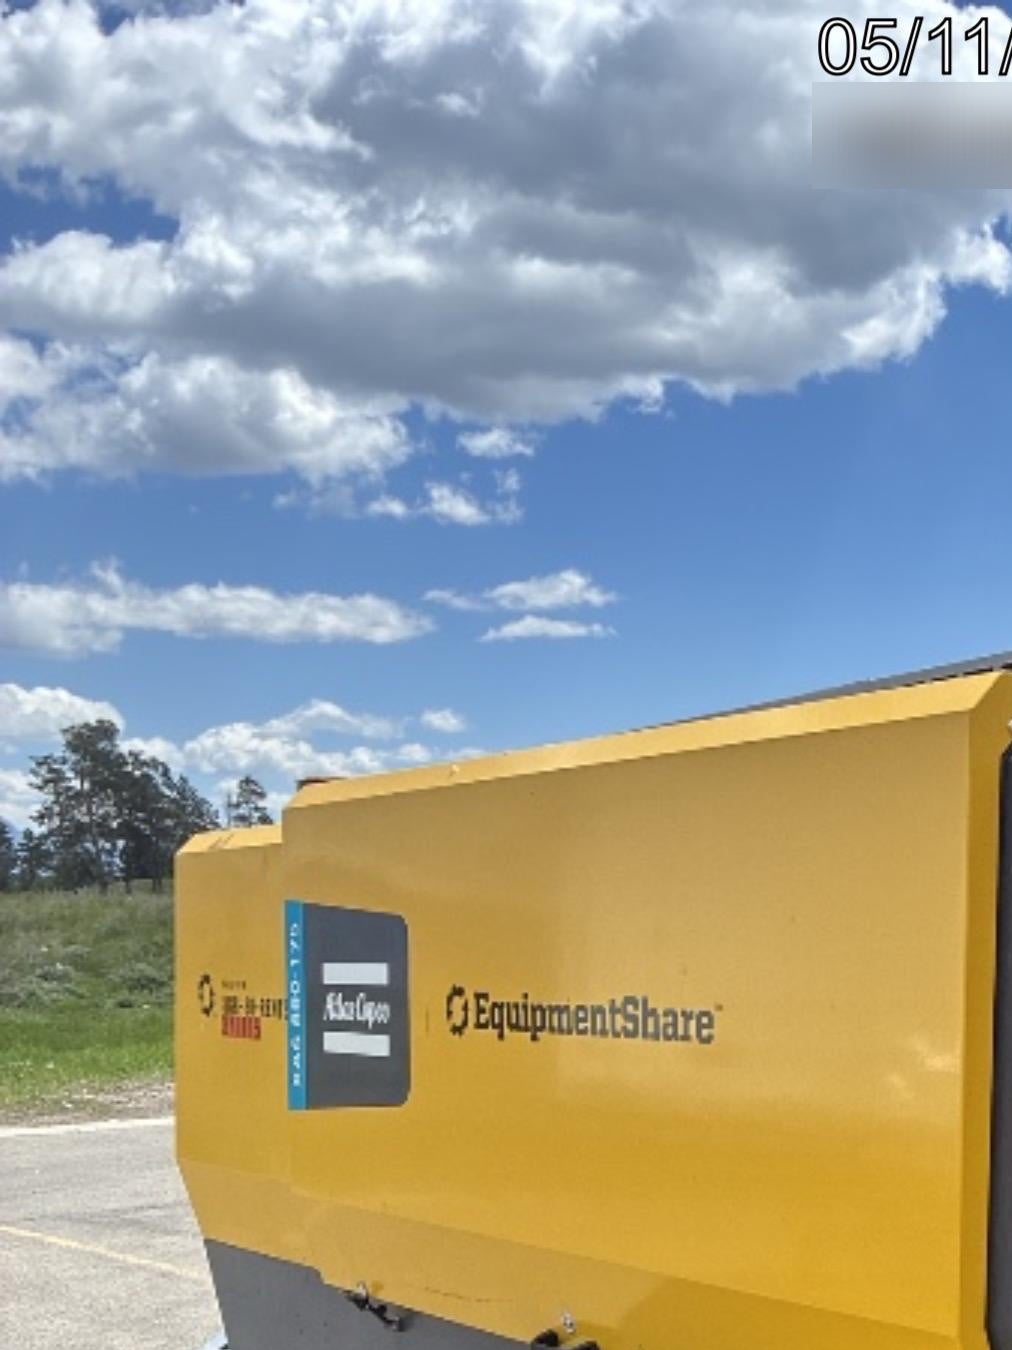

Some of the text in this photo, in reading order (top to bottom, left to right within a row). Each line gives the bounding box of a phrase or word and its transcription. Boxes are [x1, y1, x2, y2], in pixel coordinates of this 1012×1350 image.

[323, 991, 390, 1030] Atlas Copco
[473, 992, 715, 1044] EquipmentShare
